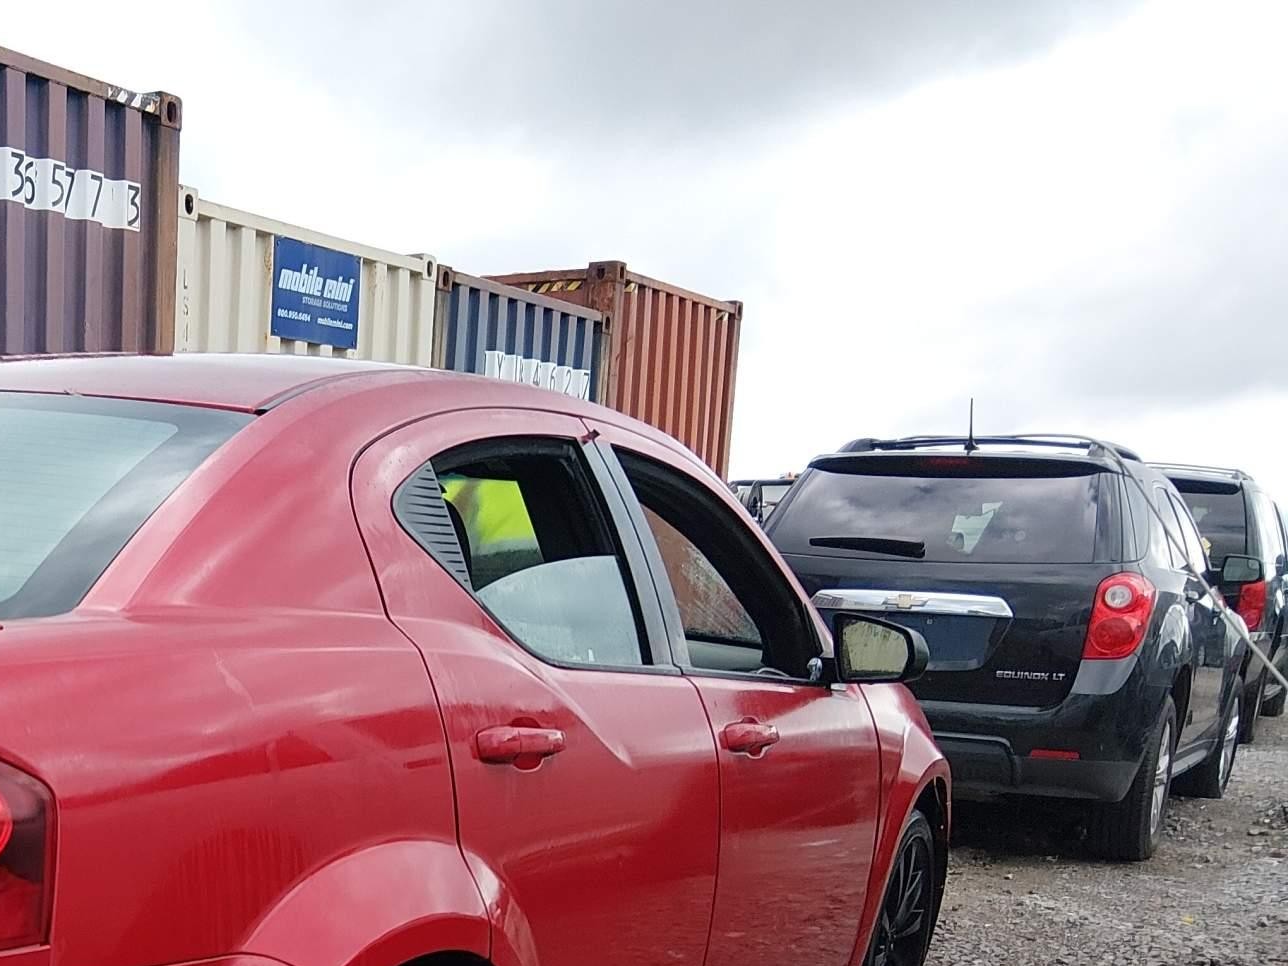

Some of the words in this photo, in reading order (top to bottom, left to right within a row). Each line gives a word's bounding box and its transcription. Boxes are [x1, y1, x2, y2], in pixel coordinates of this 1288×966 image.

[278, 264, 324, 297] mobile
[323, 276, 355, 303] mini
[996, 670, 1050, 681] EQUINOX
[1052, 672, 1066, 681] LT
